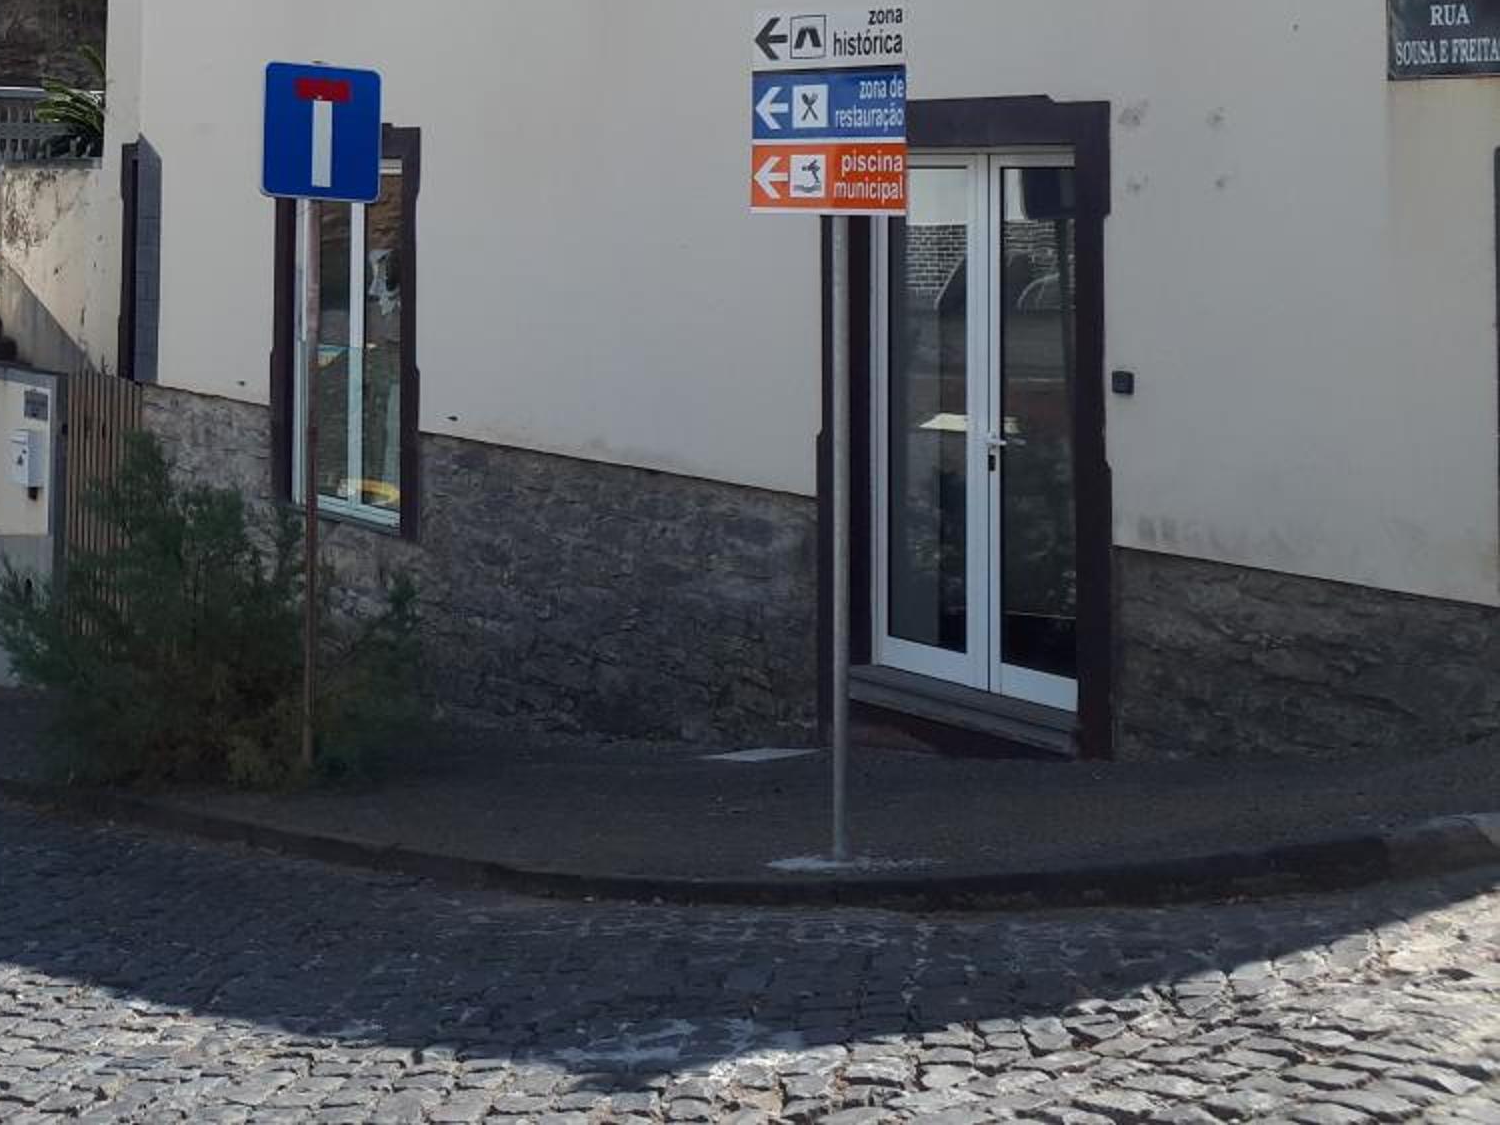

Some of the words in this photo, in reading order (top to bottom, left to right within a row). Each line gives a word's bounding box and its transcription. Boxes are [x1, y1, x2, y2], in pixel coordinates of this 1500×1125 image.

[868, 7, 903, 25] zona
[1430, 3, 1470, 26] RUA
[833, 29, 903, 57] histórica
[1395, 40, 1437, 65] SOUSA
[1440, 39, 1449, 63] E
[1451, 37, 1500, 63] FREITA
[859, 79, 887, 99] zona
[889, 76, 904, 98] de
[835, 102, 904, 132] restauração
[841, 149, 903, 176] piscina
[833, 176, 903, 204] municipal
